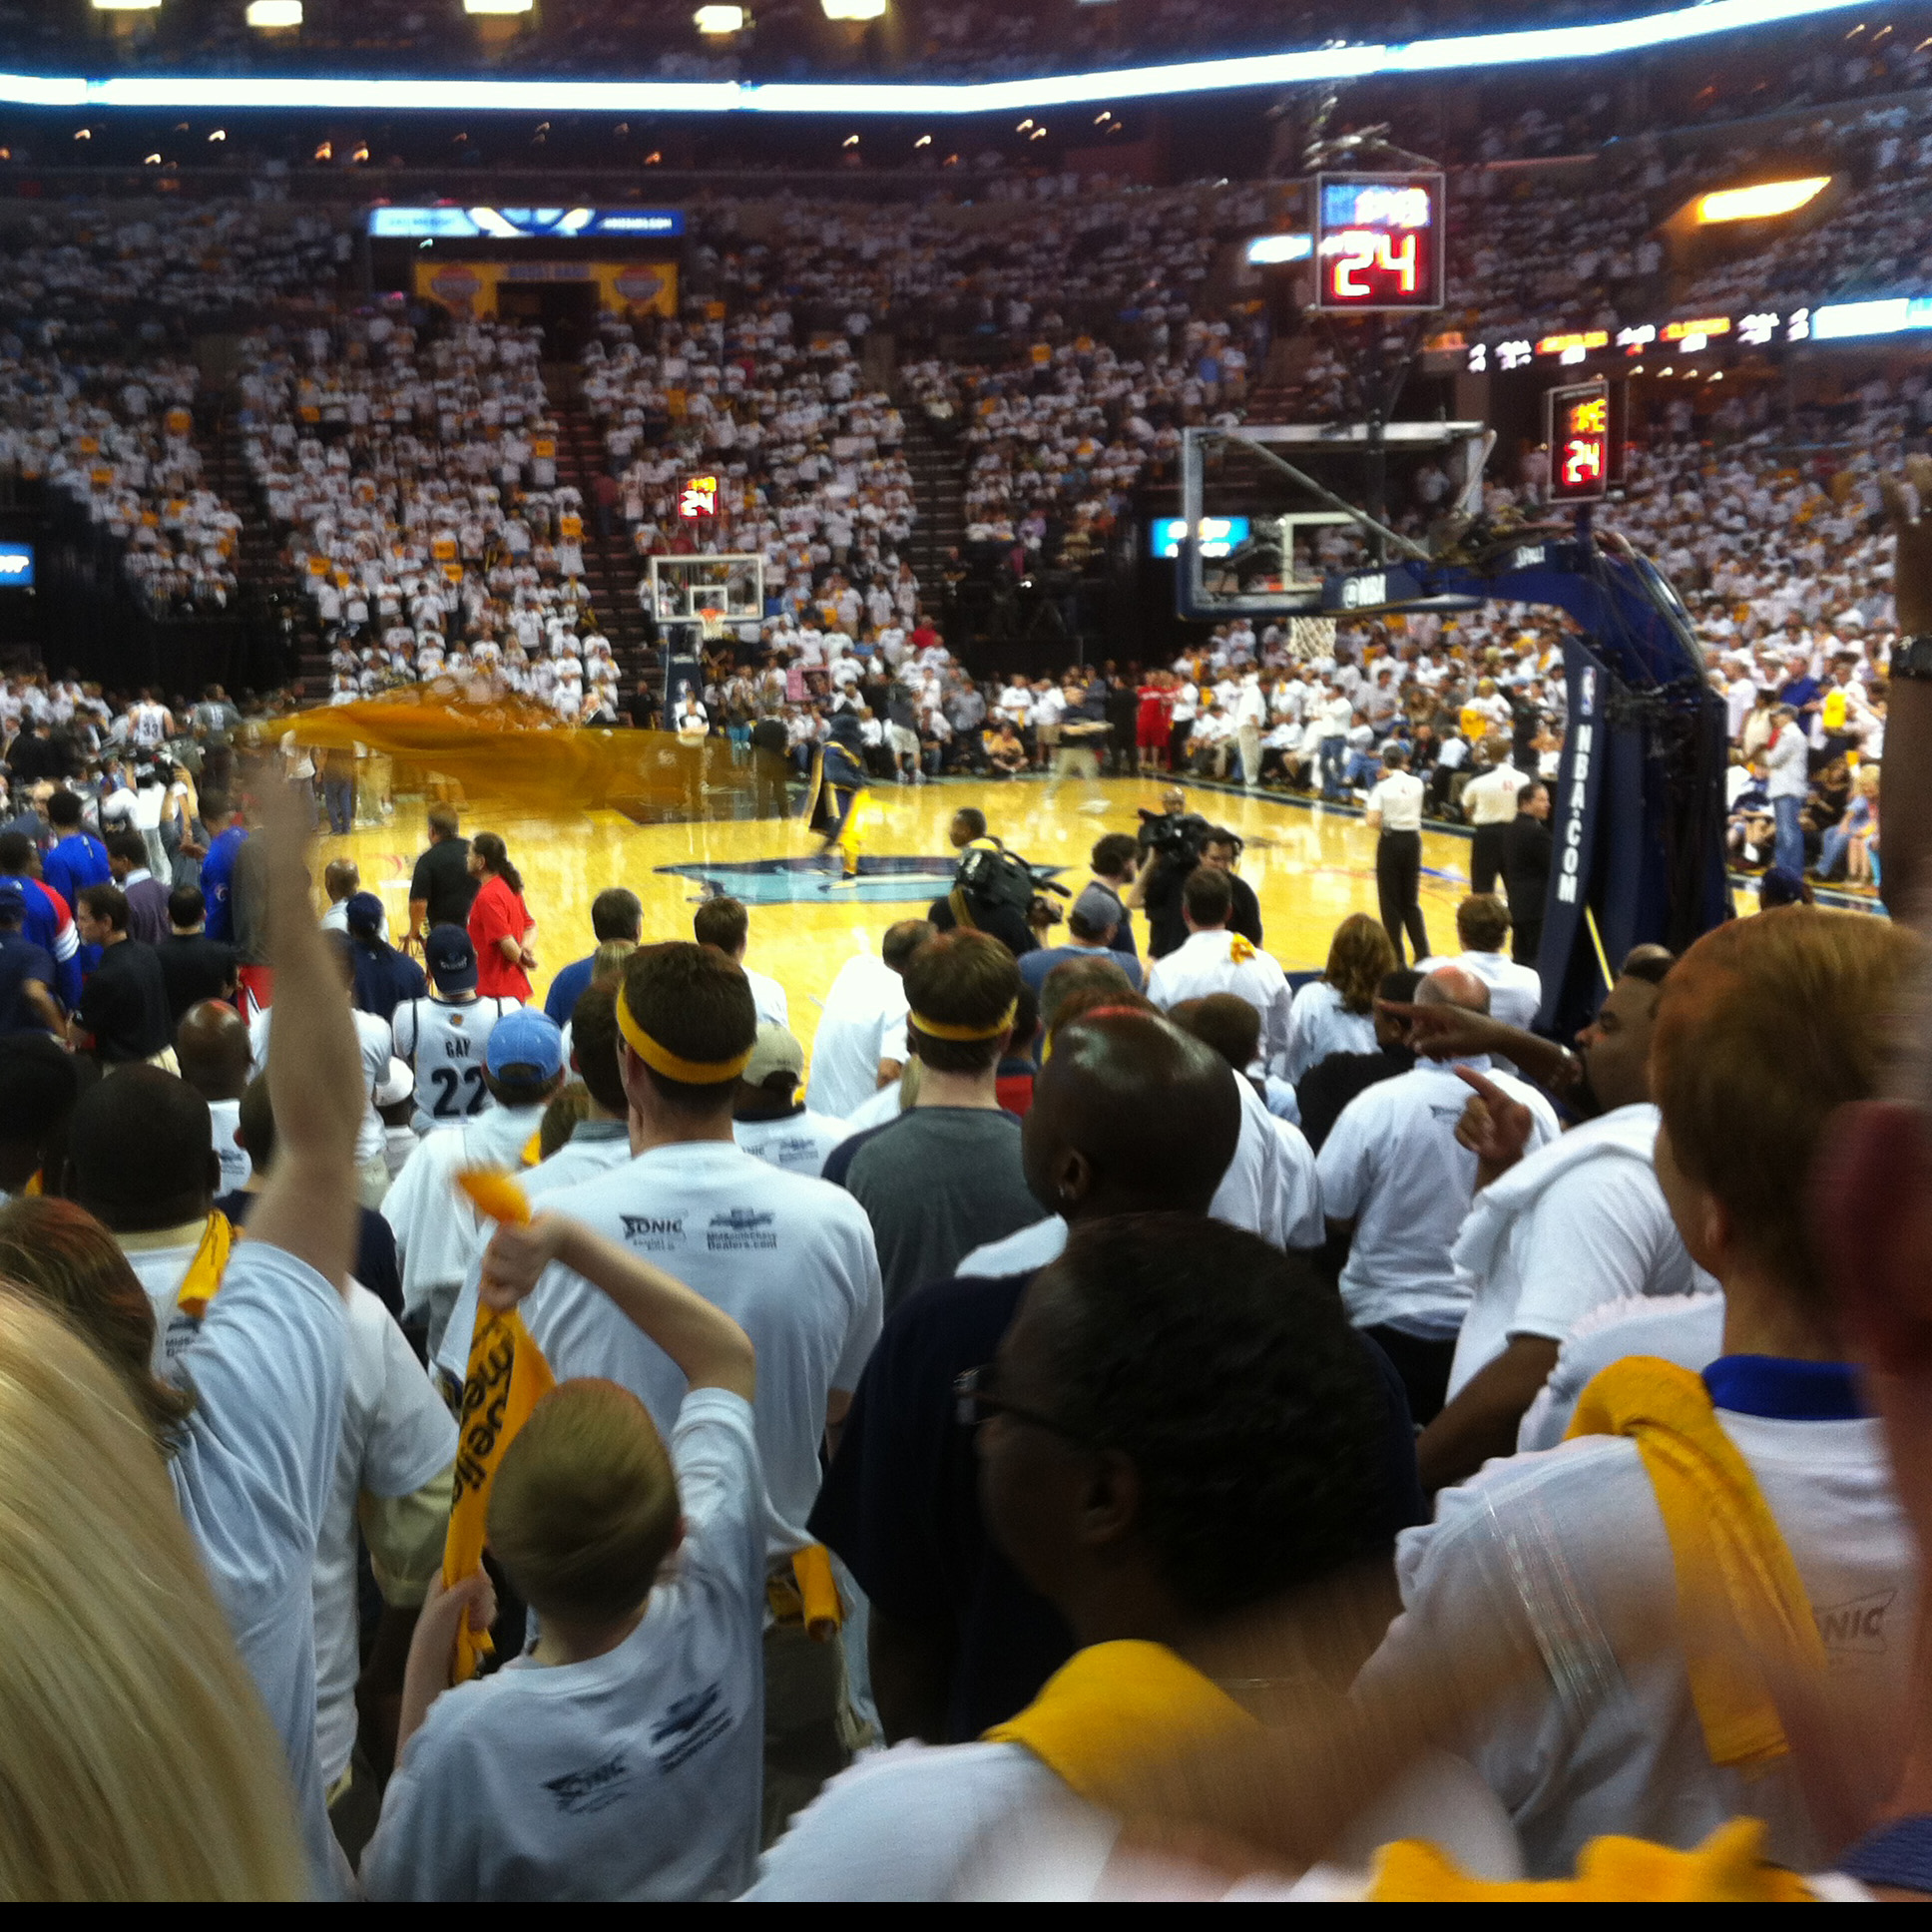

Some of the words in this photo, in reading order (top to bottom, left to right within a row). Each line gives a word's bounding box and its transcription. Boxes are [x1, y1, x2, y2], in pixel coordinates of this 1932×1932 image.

[1332, 231, 1417, 297] 24
[1566, 439, 1601, 483] 24
[680, 490, 715, 517] 24
[1558, 724, 1594, 904] NBA.COM
[445, 1037, 471, 1059] GAY
[431, 1065, 488, 1119] 22
[622, 1215, 684, 1238] SONIC
